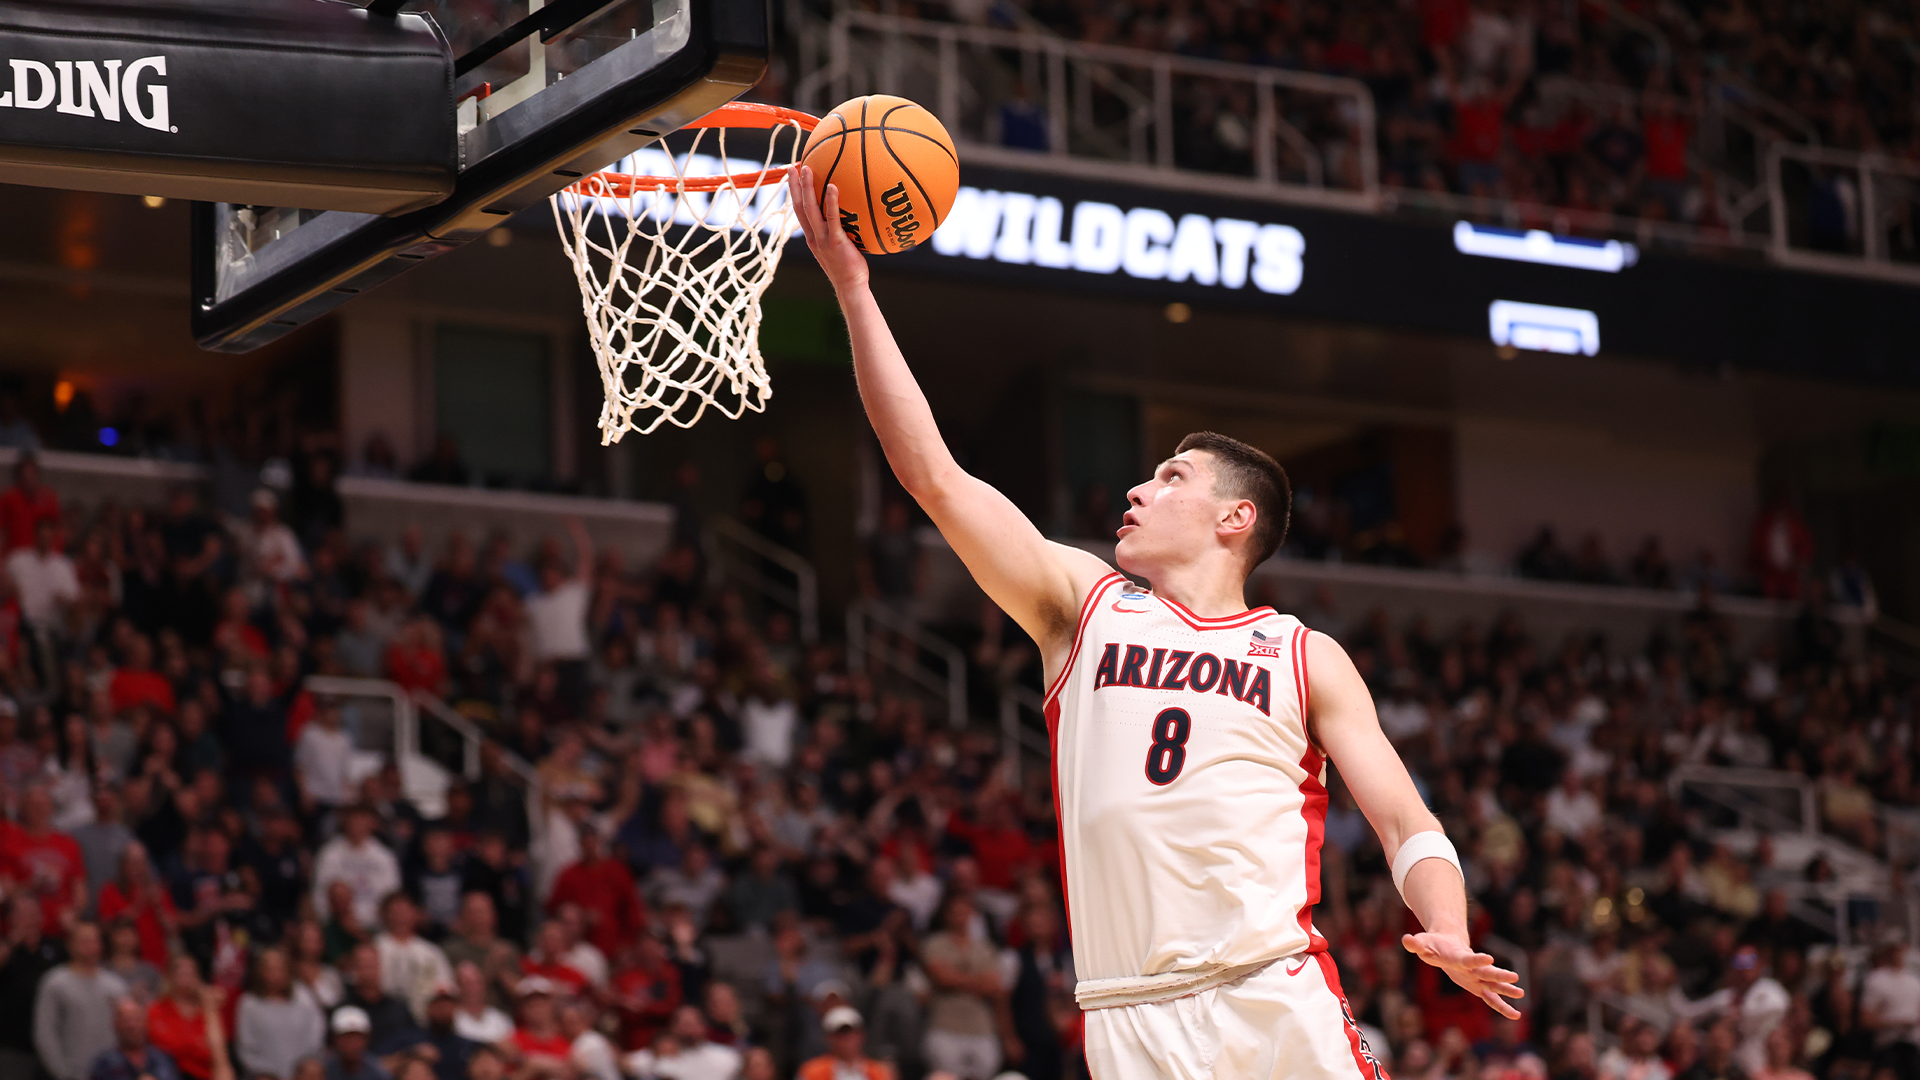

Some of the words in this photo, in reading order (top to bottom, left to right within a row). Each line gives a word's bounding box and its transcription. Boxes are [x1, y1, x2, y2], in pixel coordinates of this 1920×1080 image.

[880, 180, 920, 251] Wilso
[931, 186, 1305, 294] WILDCATS
[1094, 642, 1271, 717] ARIZONA
[1247, 642, 1281, 658] XII
[1145, 706, 1192, 786] 8
